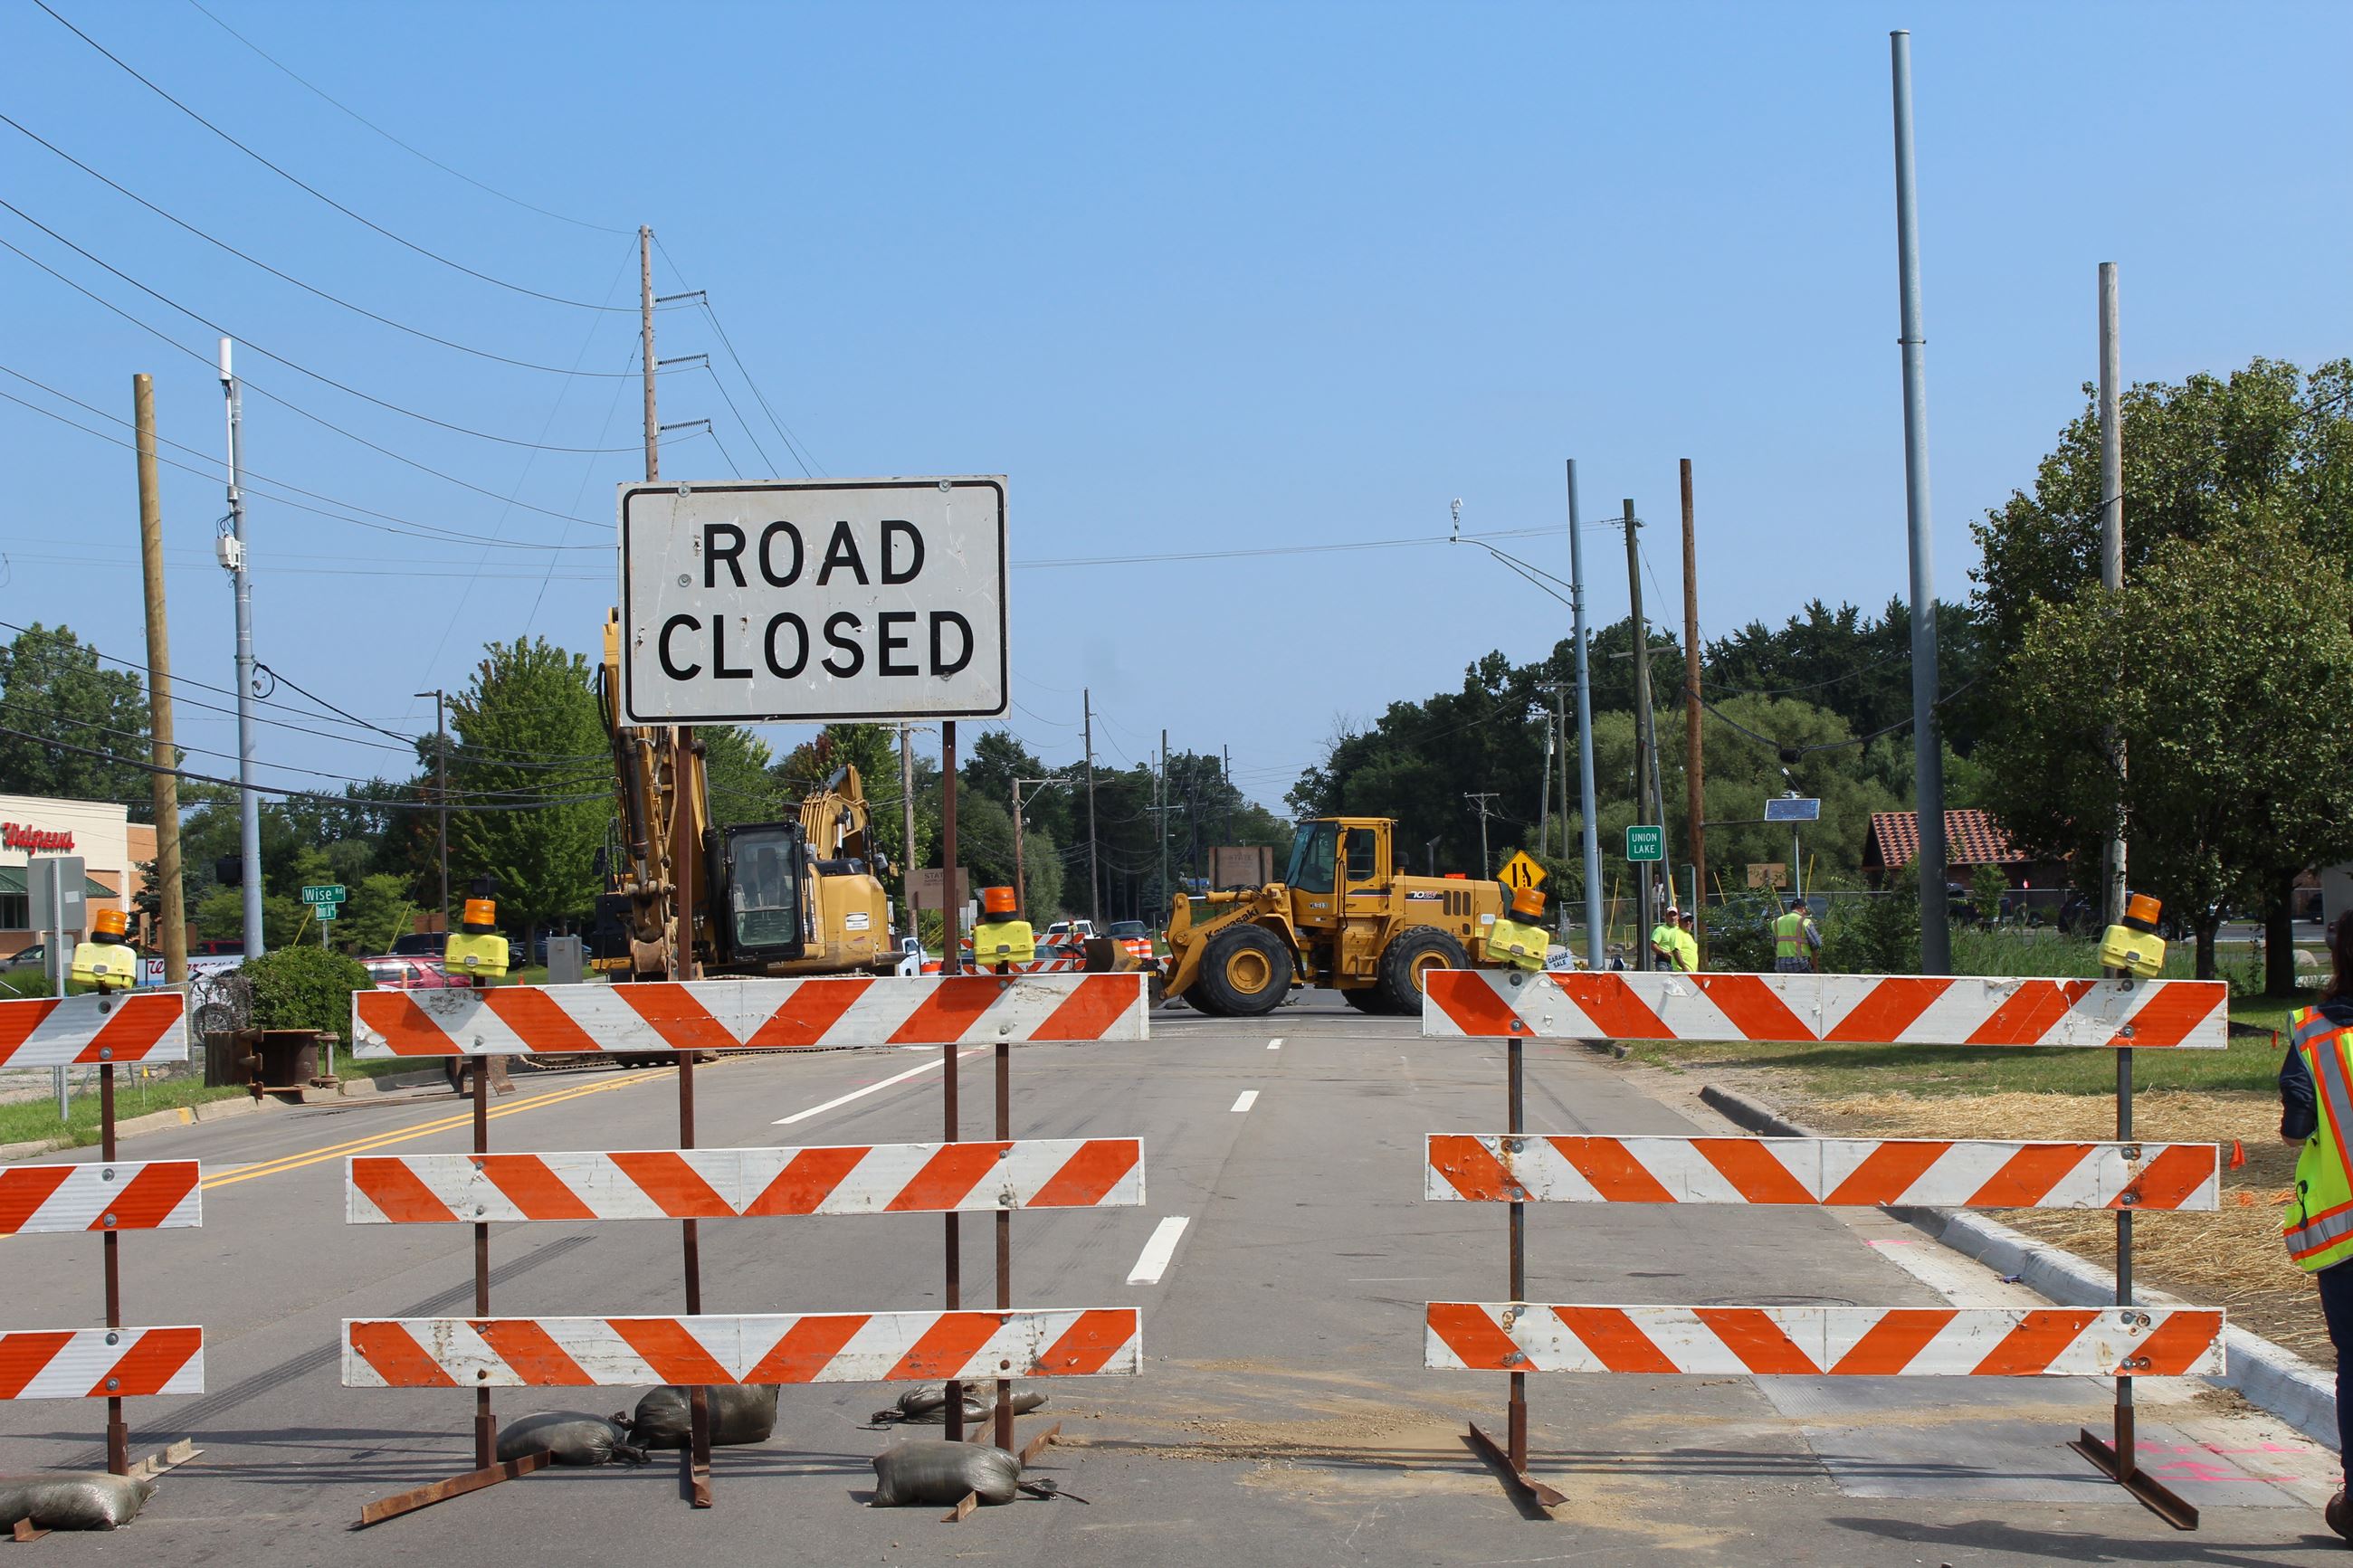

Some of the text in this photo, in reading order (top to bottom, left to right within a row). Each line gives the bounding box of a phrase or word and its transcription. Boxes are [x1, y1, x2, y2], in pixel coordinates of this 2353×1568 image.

[702, 519, 925, 589] ROAD
[658, 611, 974, 681] CLOSED
[2, 822, 75, 855] Walgreens
[1632, 832, 1658, 842] UNION
[1634, 844, 1655, 854] LAKE
[923, 871, 944, 879] STAT
[304, 887, 343, 901] Wise Rd
[1548, 952, 1568, 964] GARAGE
[1553, 959, 1567, 968] SALE
